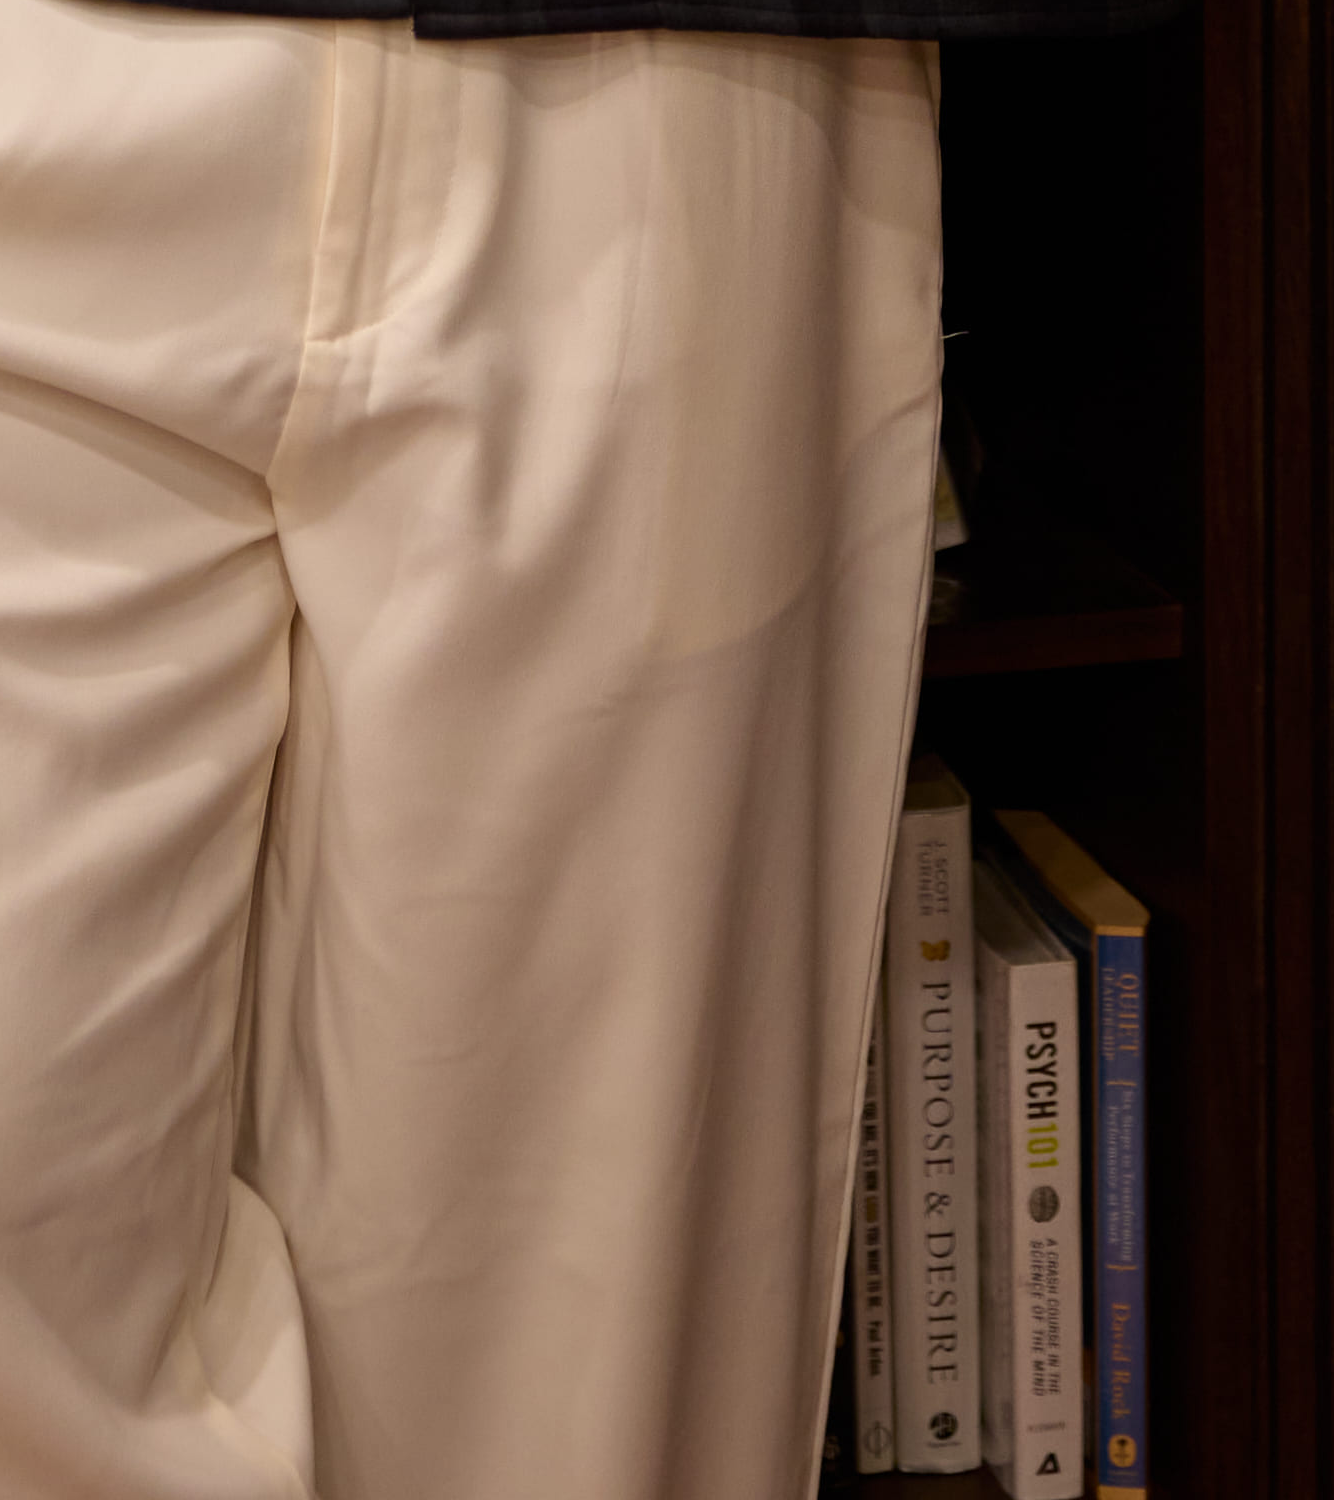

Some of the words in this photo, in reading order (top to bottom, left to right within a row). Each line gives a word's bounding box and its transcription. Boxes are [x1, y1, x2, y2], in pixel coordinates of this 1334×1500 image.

[922, 981, 955, 1177] PURPOSE
[1026, 1021, 1059, 1169] PSYCH101
[925, 1191, 954, 1217] &
[927, 1232, 958, 1382] DESIRE
